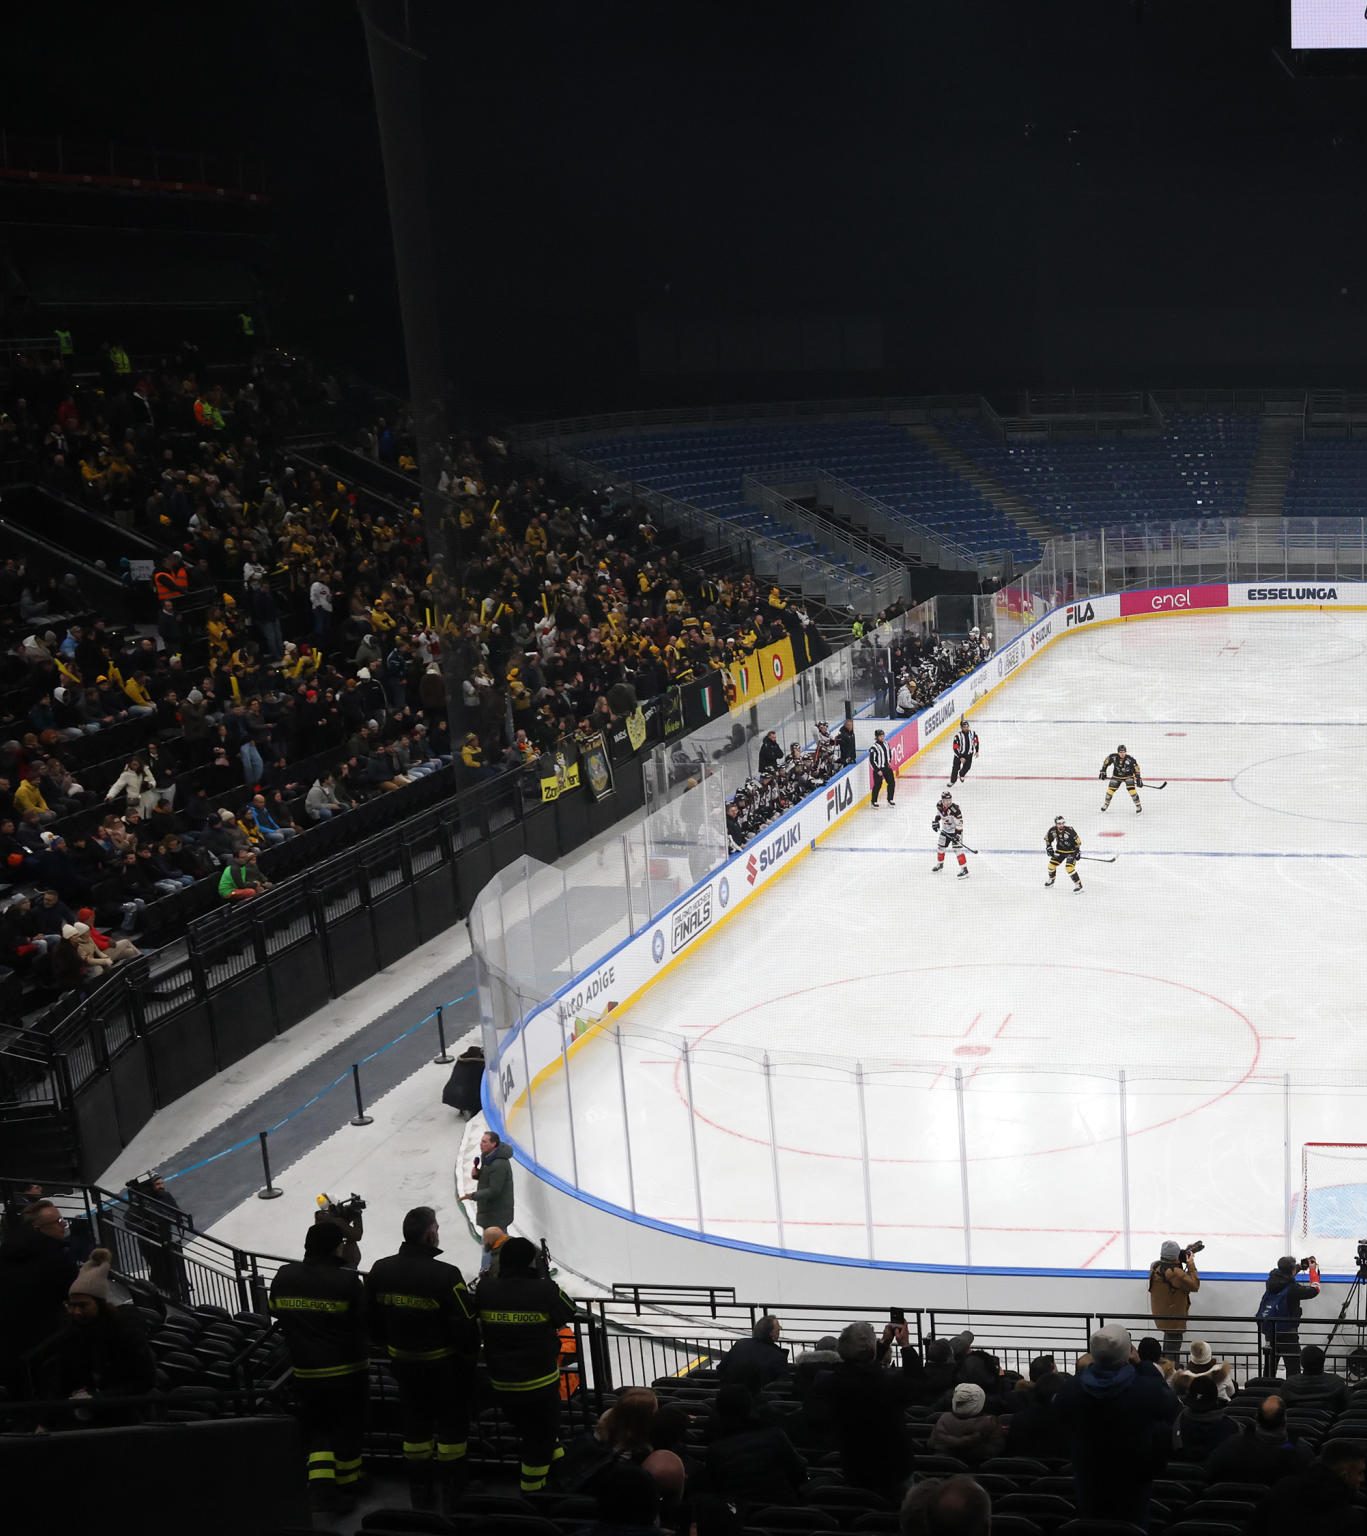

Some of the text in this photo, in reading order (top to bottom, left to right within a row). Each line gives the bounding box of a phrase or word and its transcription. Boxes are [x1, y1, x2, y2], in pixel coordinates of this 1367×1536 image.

[1151, 589, 1191, 610] enel
[1247, 588, 1338, 600] ESSELUNGA
[1066, 602, 1095, 627] FILA
[1036, 621, 1052, 645] SUZUKI
[925, 699, 955, 736] ESSELUNGA
[891, 736, 904, 764] nel
[826, 777, 854, 822] FILA
[759, 822, 801, 872] SUZUKI
[674, 901, 711, 947] FINALS
[512, 1313, 540, 1322] FUOCO
